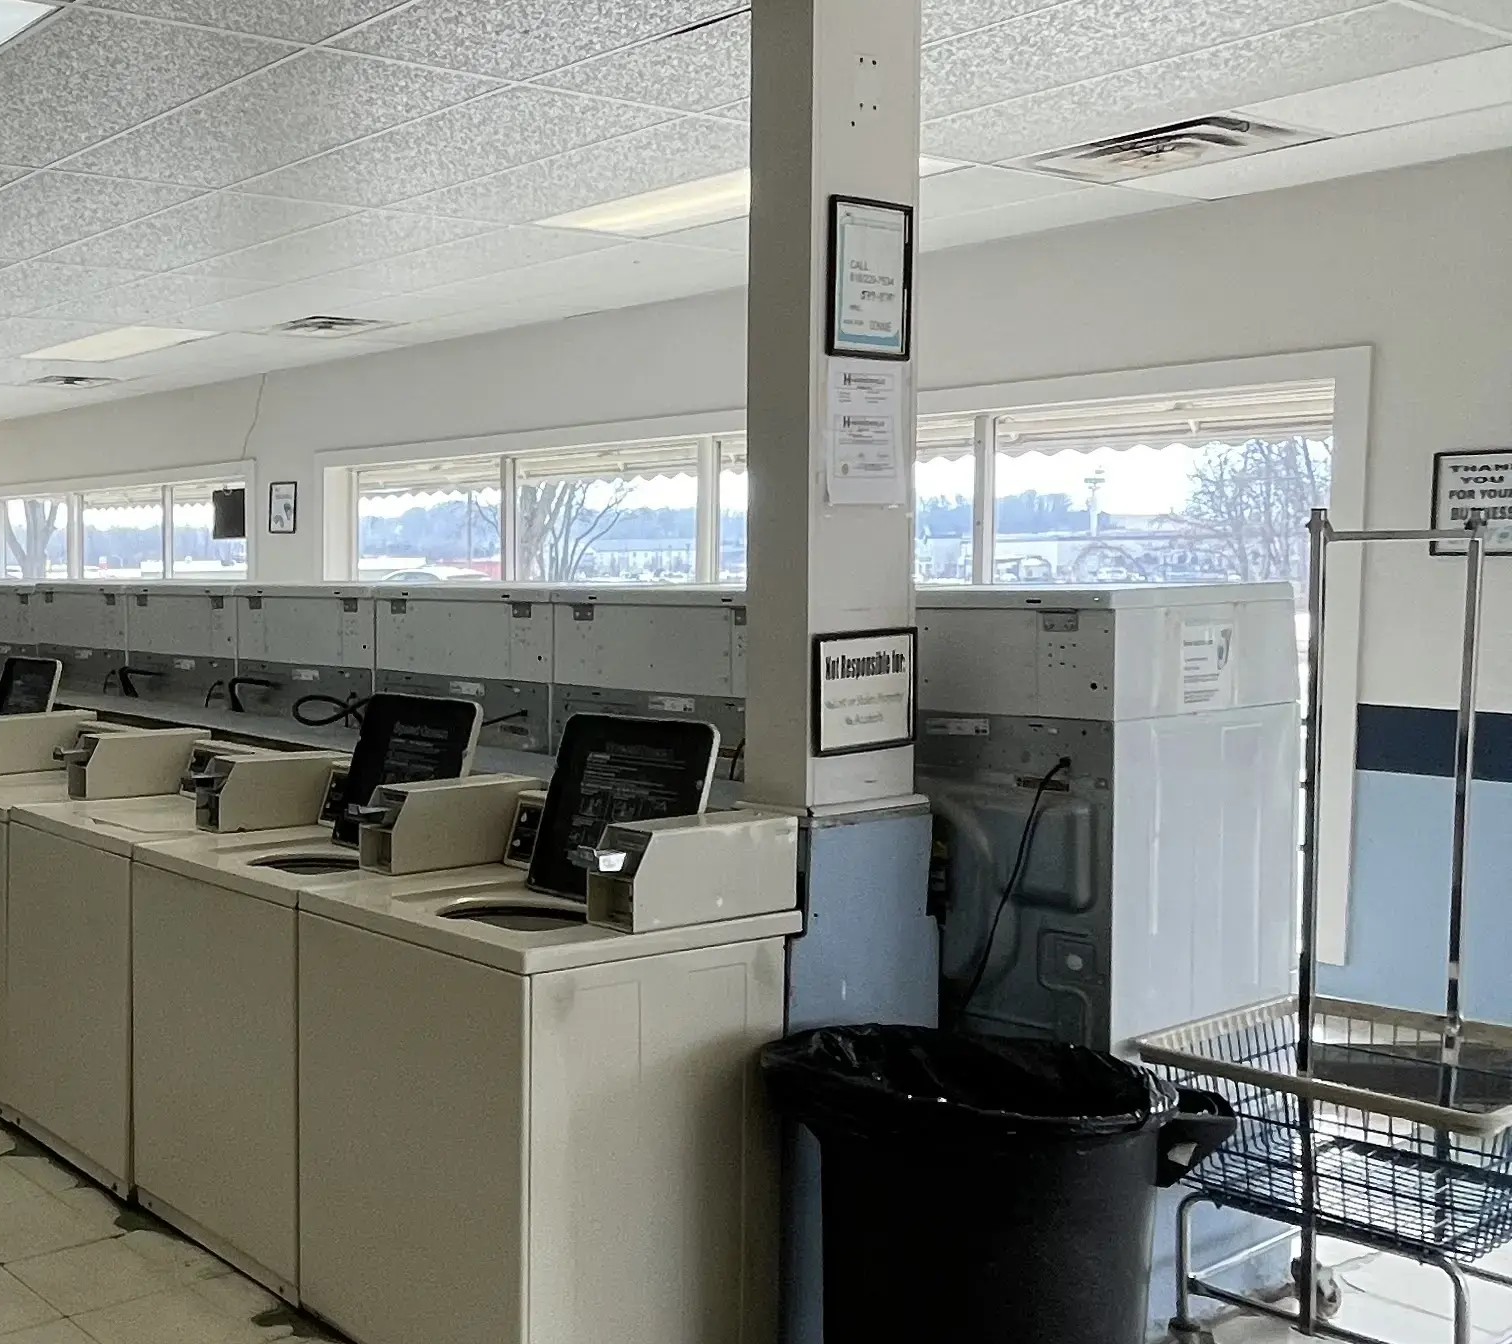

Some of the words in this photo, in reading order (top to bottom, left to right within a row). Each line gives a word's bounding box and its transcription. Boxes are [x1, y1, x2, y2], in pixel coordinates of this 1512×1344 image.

[1460, 475, 1504, 484] YOU
[1449, 490, 1475, 499] FOR
[826, 656, 840, 680] Not
[841, 651, 890, 680] Responsible
